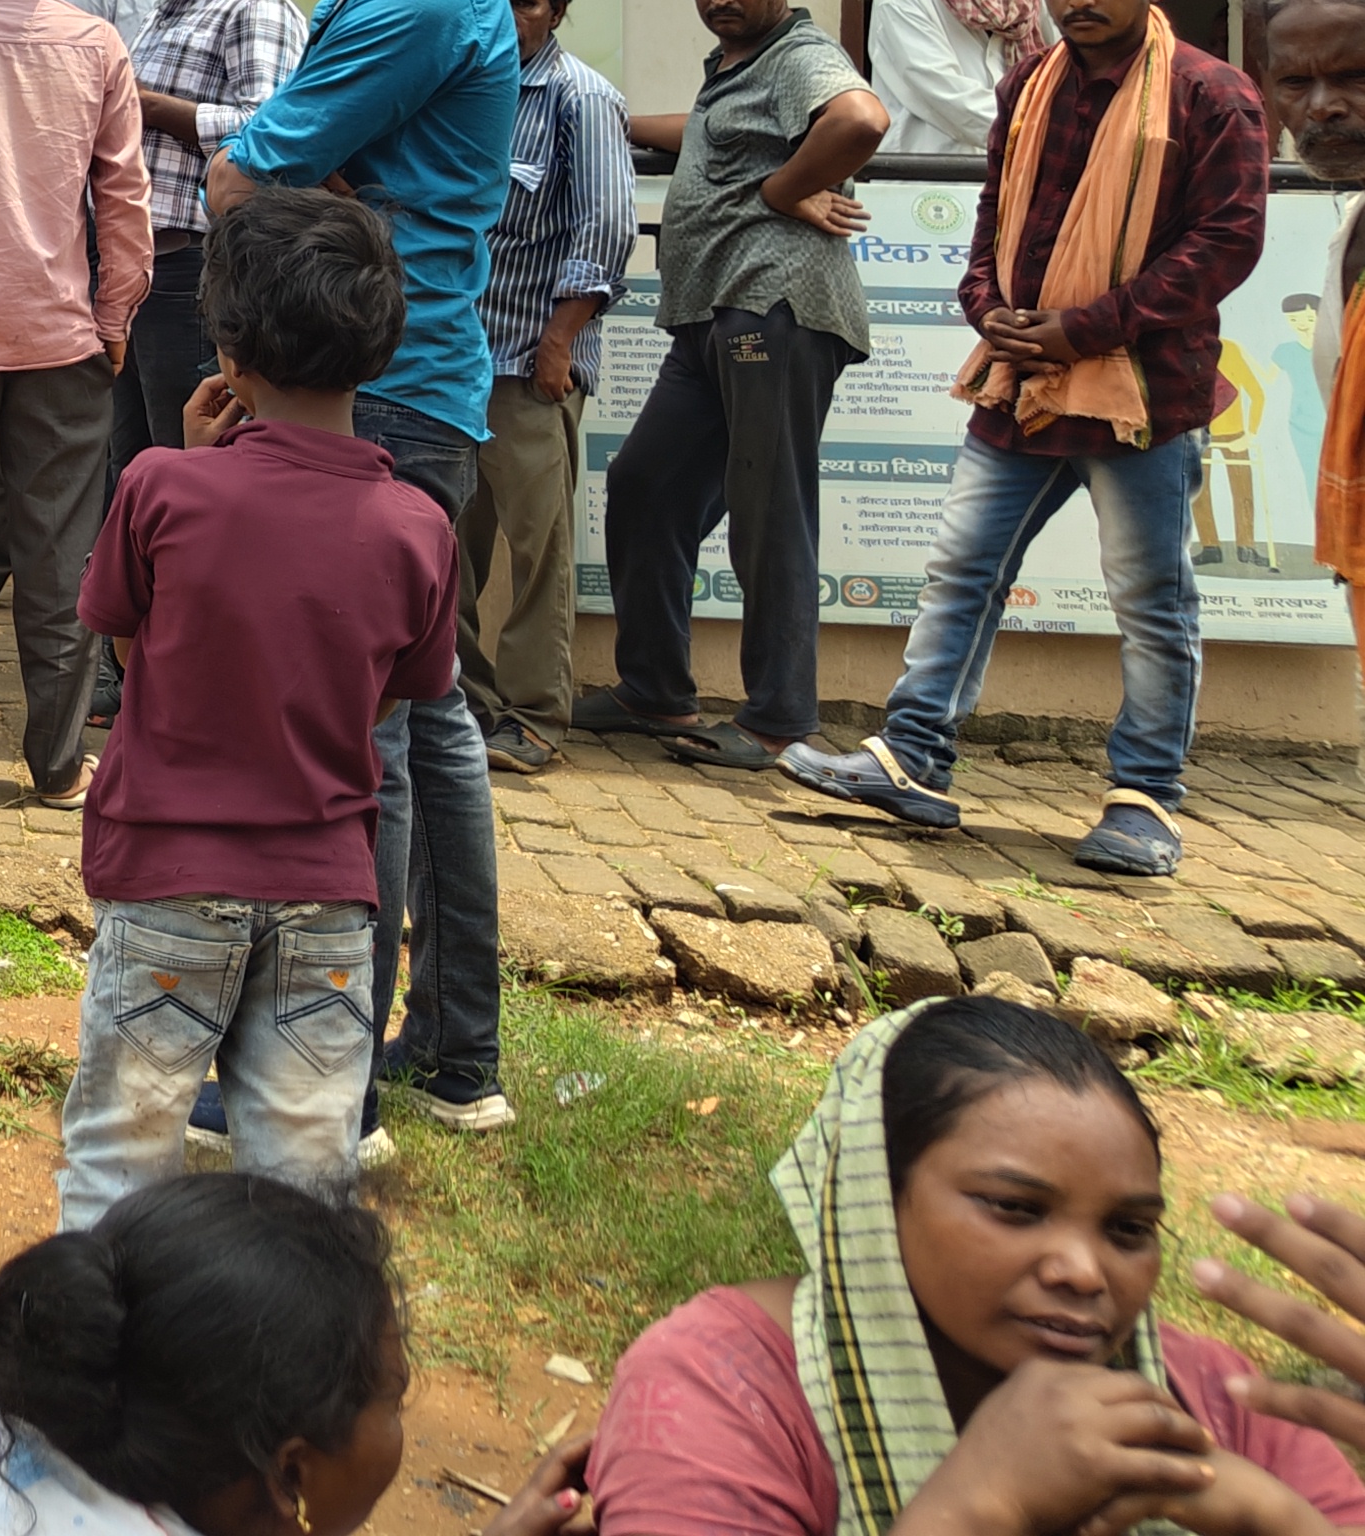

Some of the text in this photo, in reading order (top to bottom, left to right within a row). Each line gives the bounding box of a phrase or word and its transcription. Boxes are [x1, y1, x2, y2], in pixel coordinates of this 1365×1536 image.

[866, 300, 943, 316] स्वास्थ्य
[635, 338, 643, 346] में
[727, 332, 762, 345] TOMMY
[867, 359, 912, 368] की बीमारी
[876, 370, 884, 379] में
[858, 383, 909, 391] गतिशीलता
[858, 457, 948, 476] का विशेष
[857, 496, 888, 505] डॉक्टर
[858, 509, 885, 519] सेवन
[888, 510, 902, 519] को
[858, 524, 911, 533] अकेलापन
[914, 523, 923, 533] से
[858, 538, 880, 548] खुश
[884, 537, 899, 546] एवं
[1051, 587, 1327, 608] राष्ट्रीय झारखण्ड
[1033, 620, 1075, 632] गुमला
